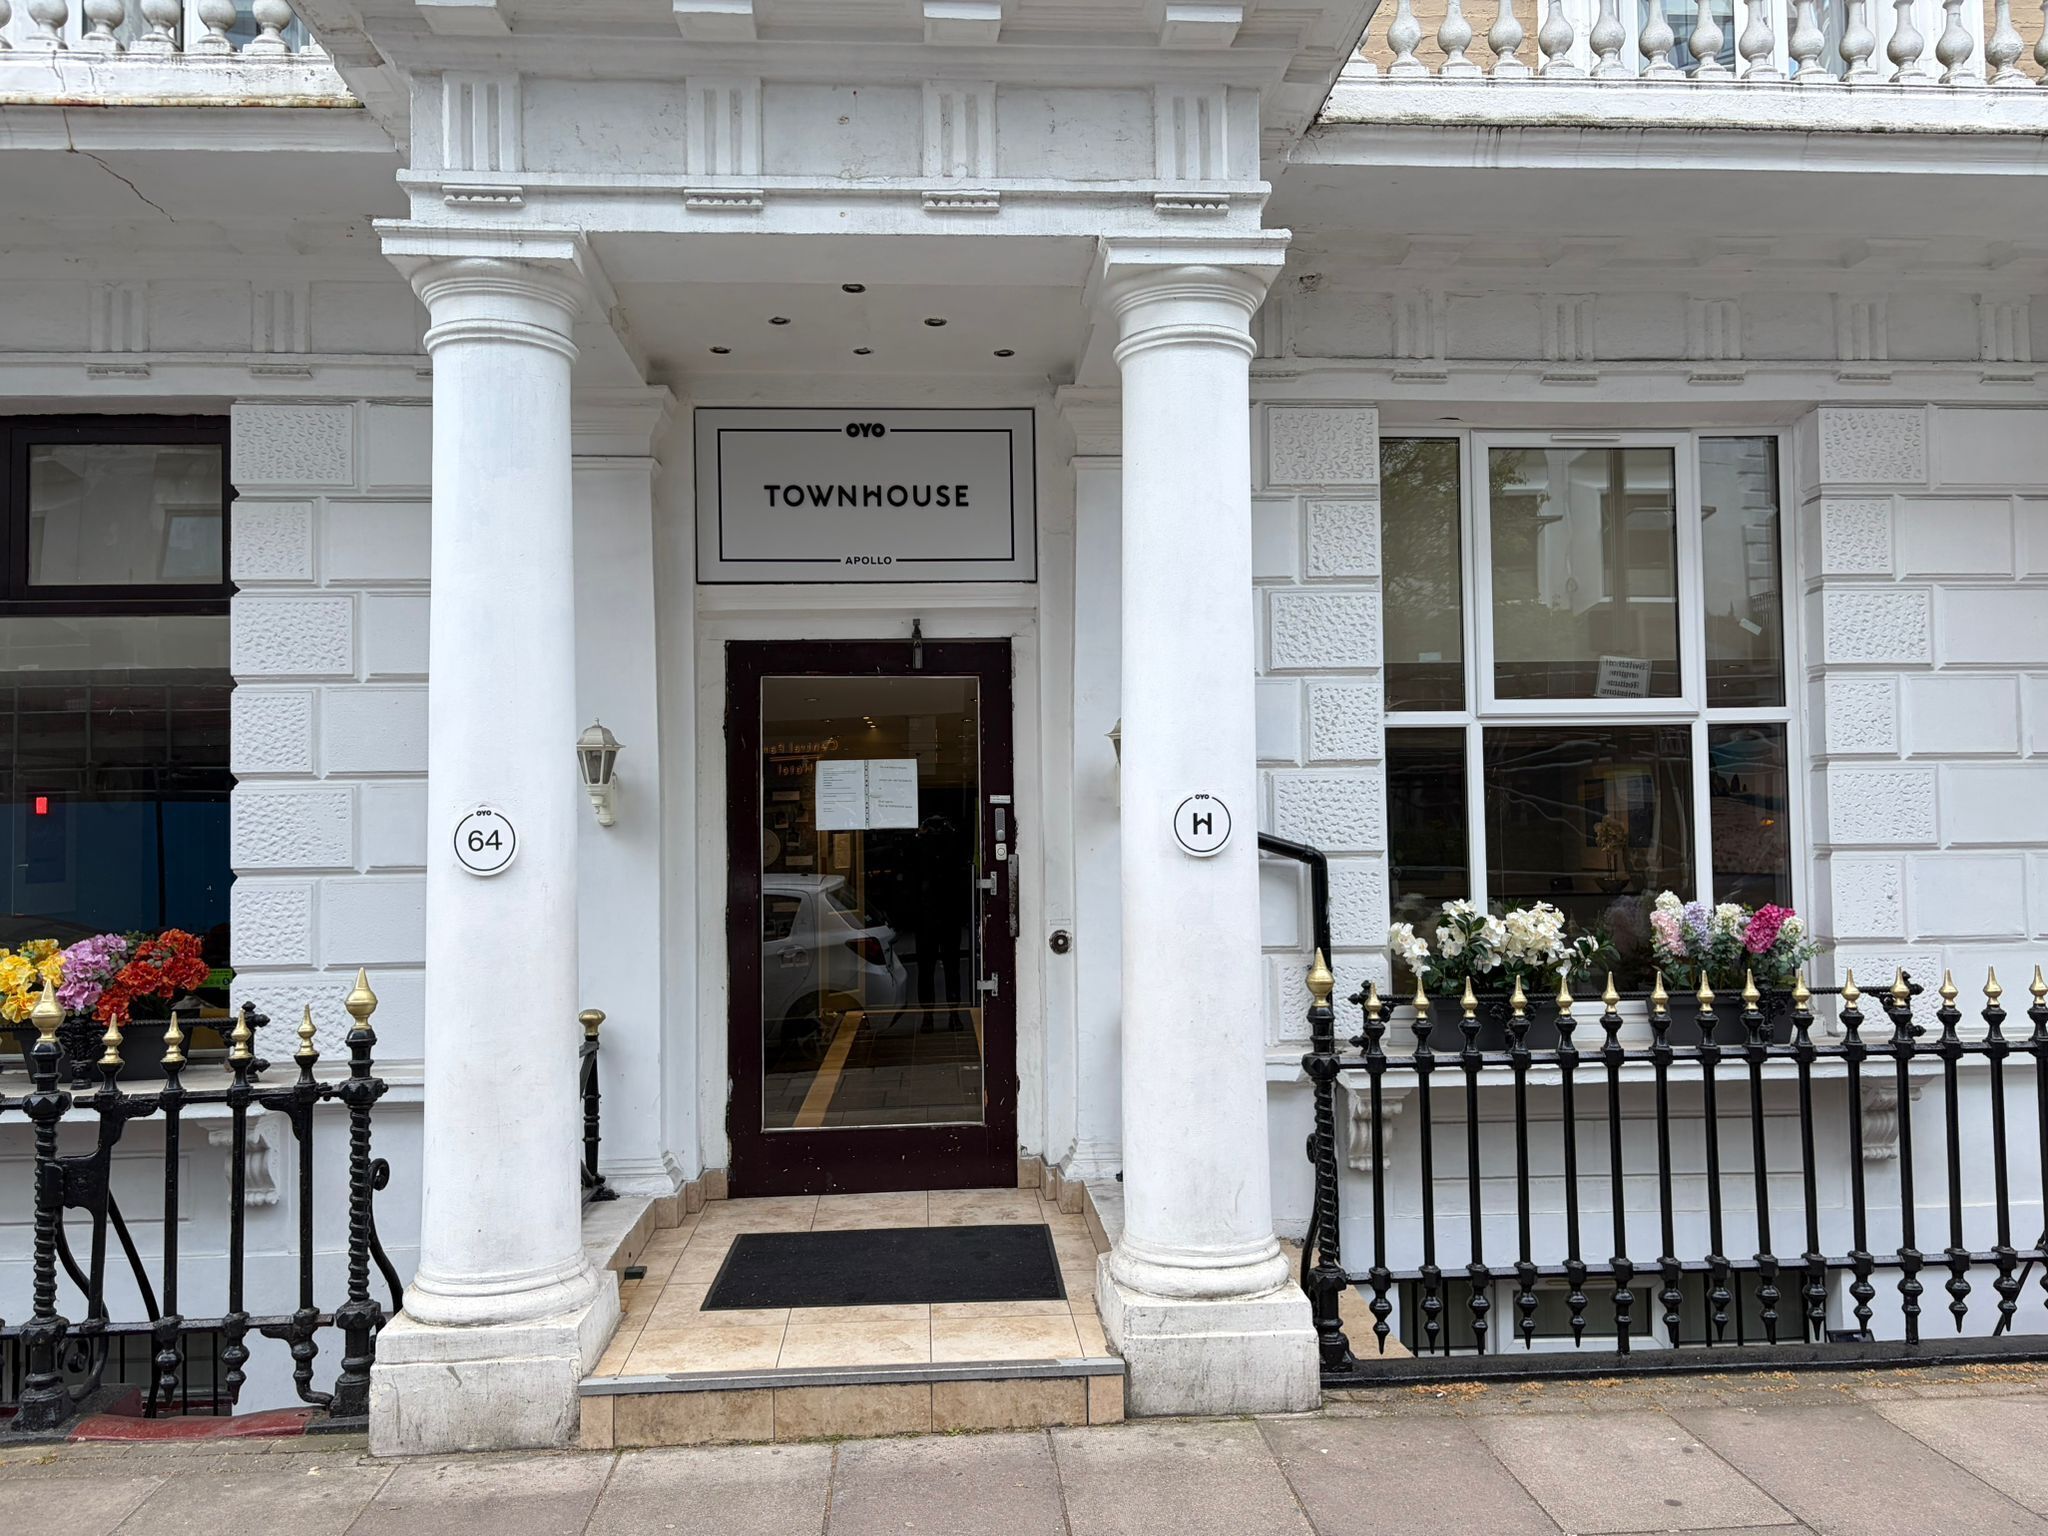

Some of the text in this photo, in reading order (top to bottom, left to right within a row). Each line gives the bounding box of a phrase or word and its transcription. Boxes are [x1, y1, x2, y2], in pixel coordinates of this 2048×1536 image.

[846, 423, 886, 438] OYO
[763, 485, 969, 508] TOWNHOUSE
[845, 556, 892, 566] APOLLO
[1193, 812, 1212, 835] H
[468, 829, 503, 852] 64
